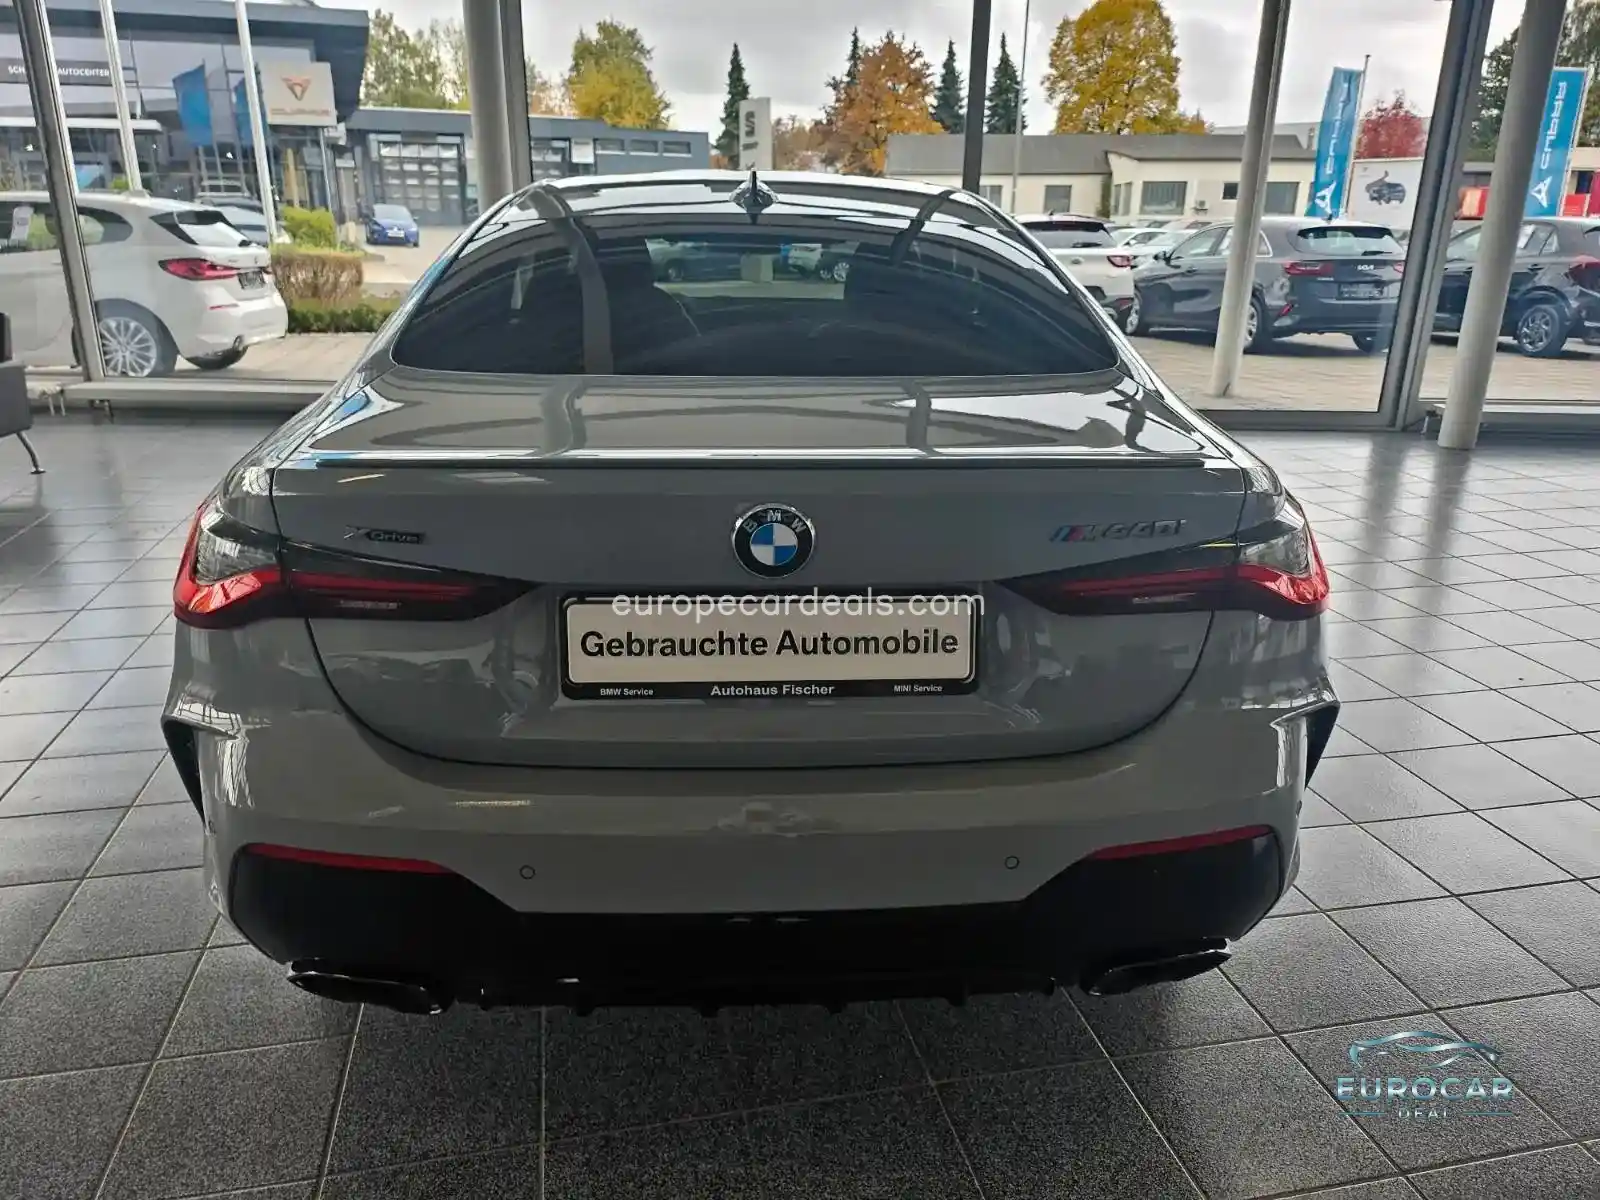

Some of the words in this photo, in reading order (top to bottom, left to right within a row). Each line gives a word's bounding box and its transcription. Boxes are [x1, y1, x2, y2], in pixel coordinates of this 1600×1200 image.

[742, 509, 807, 534] BMW
[580, 630, 769, 657] Gebrauchte
[775, 628, 959, 656] Automobile
[600, 687, 622, 696] BMW
[623, 687, 654, 696] Service
[710, 684, 779, 697] Autohaus
[782, 683, 835, 696] Fischer
[893, 684, 912, 693] MINI
[913, 683, 943, 693] Service
